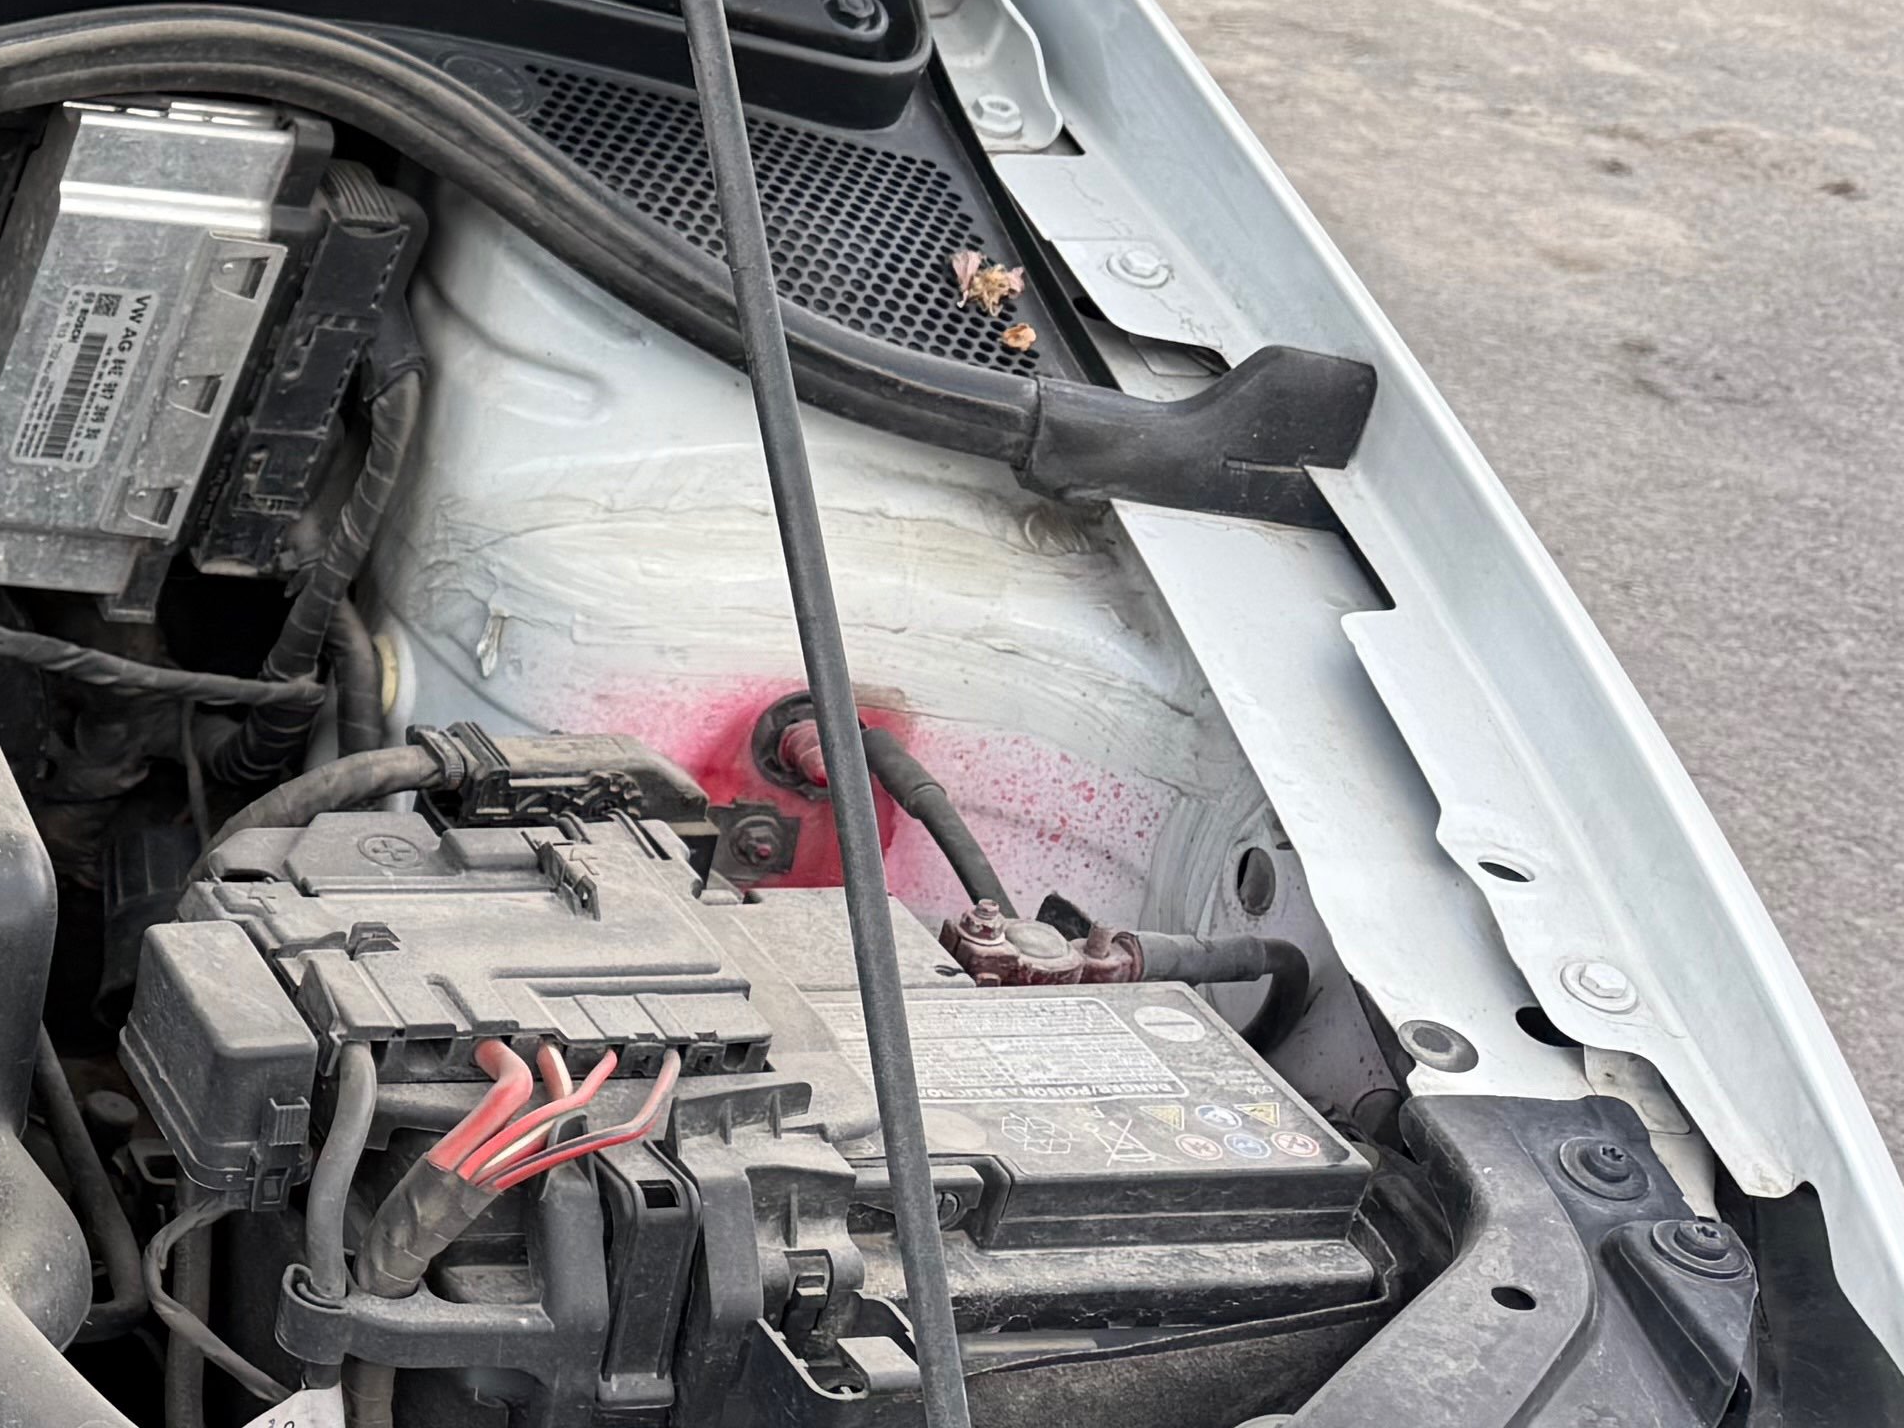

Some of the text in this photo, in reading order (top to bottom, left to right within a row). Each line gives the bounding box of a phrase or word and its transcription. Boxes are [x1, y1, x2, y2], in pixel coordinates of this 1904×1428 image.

[129, 295, 152, 324] VW
[69, 308, 89, 343] BOSCH
[117, 327, 138, 353] AG
